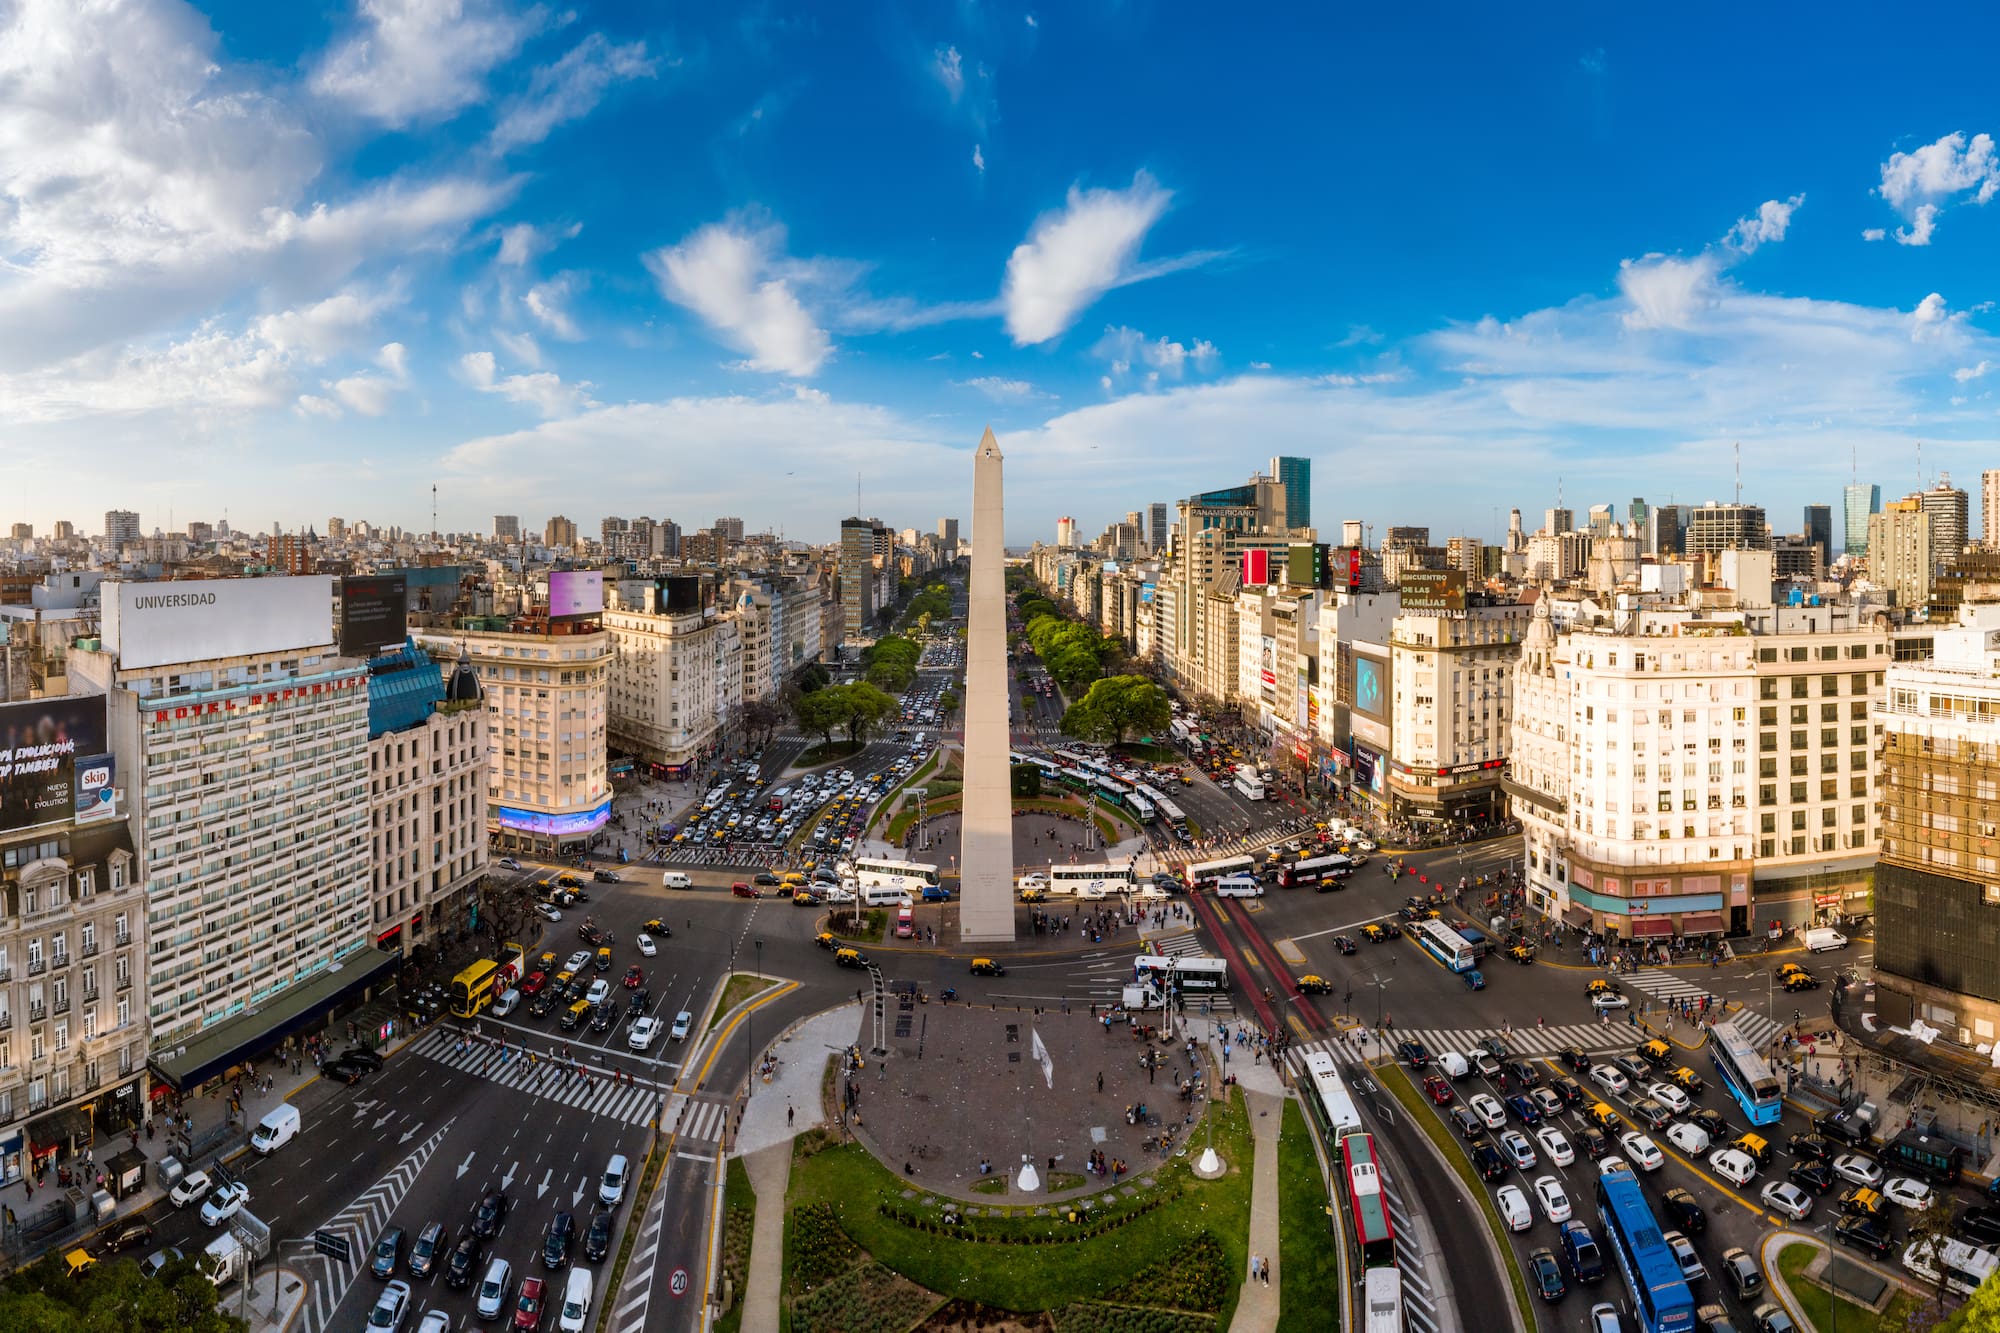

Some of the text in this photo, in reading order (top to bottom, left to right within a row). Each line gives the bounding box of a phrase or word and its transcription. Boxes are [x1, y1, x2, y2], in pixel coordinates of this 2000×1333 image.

[1191, 509, 1255, 517] PANAMERICANO
[135, 592, 216, 610] UNIVERSIDAD
[1402, 598, 1446, 607] FAMILIAS
[156, 699, 236, 722] HOTEL
[84, 770, 106, 785] skip
[47, 782, 68, 792] NUEVO
[34, 797, 69, 809] EVOLUTION
[672, 1273, 686, 1290] 20
